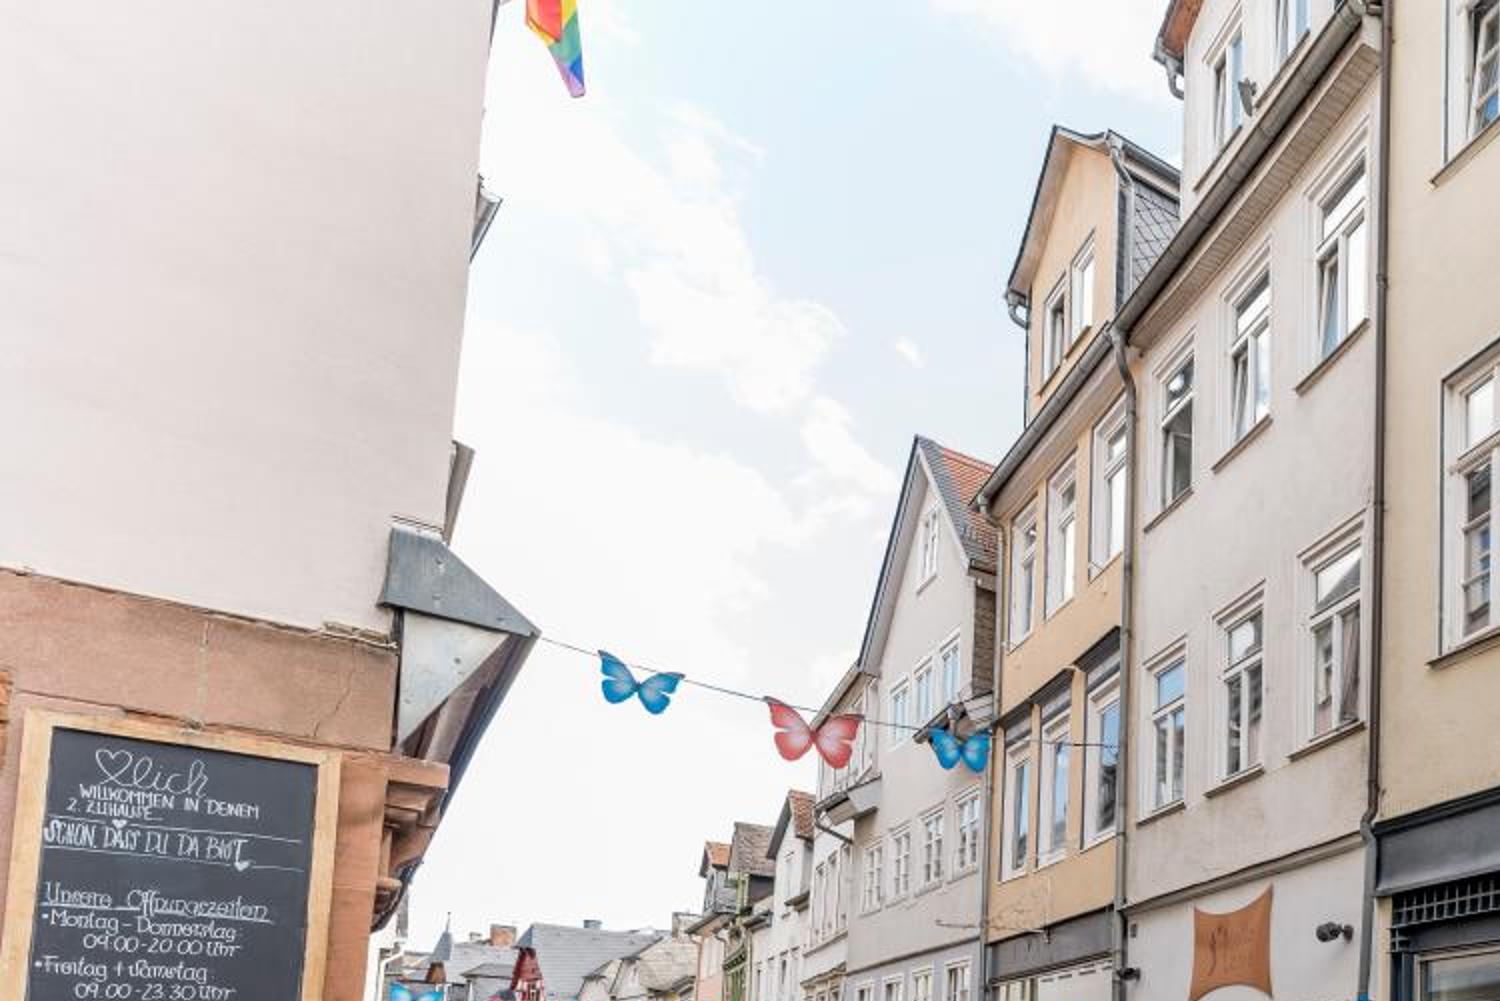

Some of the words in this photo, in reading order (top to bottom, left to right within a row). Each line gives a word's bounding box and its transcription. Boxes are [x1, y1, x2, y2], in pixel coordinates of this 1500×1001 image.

[79, 783, 175, 809] WILLKOMMEN
[184, 796, 200, 812] IN
[206, 799, 260, 820] DEINEM
[144, 831, 169, 855] DU
[178, 834, 199, 858] DA
[46, 881, 113, 906] Unsere
[51, 908, 119, 936] Montag
[206, 944, 241, 958] Uhr
[42, 955, 107, 983] Freitag
[200, 986, 237, 1001] Uhr
